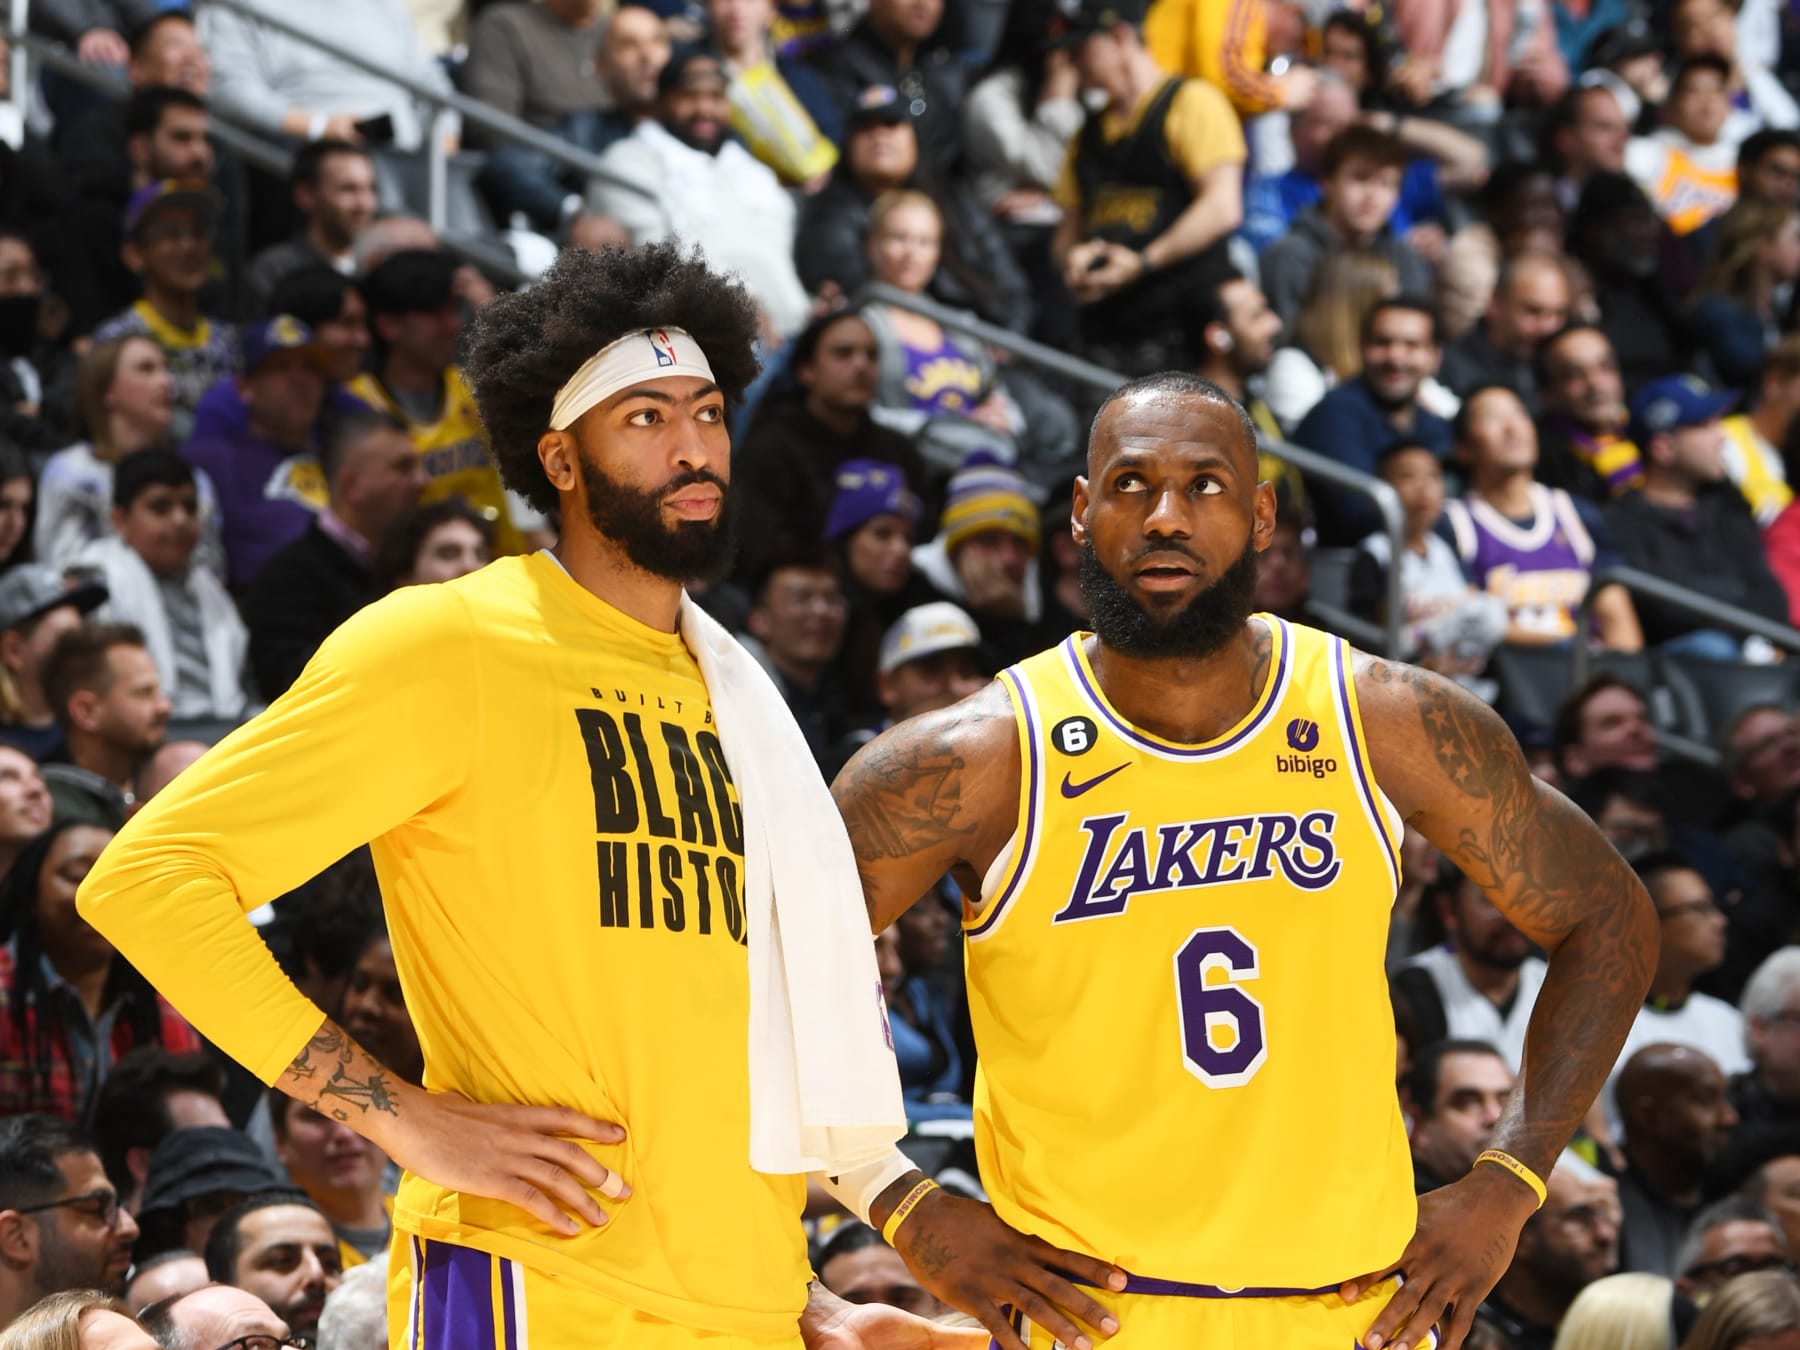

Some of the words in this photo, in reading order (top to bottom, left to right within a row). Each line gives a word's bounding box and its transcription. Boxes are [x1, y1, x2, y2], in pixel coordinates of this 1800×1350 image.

[591, 687, 683, 713] BUILT
[704, 711, 712, 724] B
[1061, 721, 1086, 753] 6
[575, 708, 745, 857] BLAC
[1276, 754, 1337, 779] bibigo
[597, 840, 747, 945] HISTO
[1051, 809, 1344, 927] LAKERS
[1172, 925, 1268, 1090] 6
[896, 1181, 934, 1217] PROMISE
